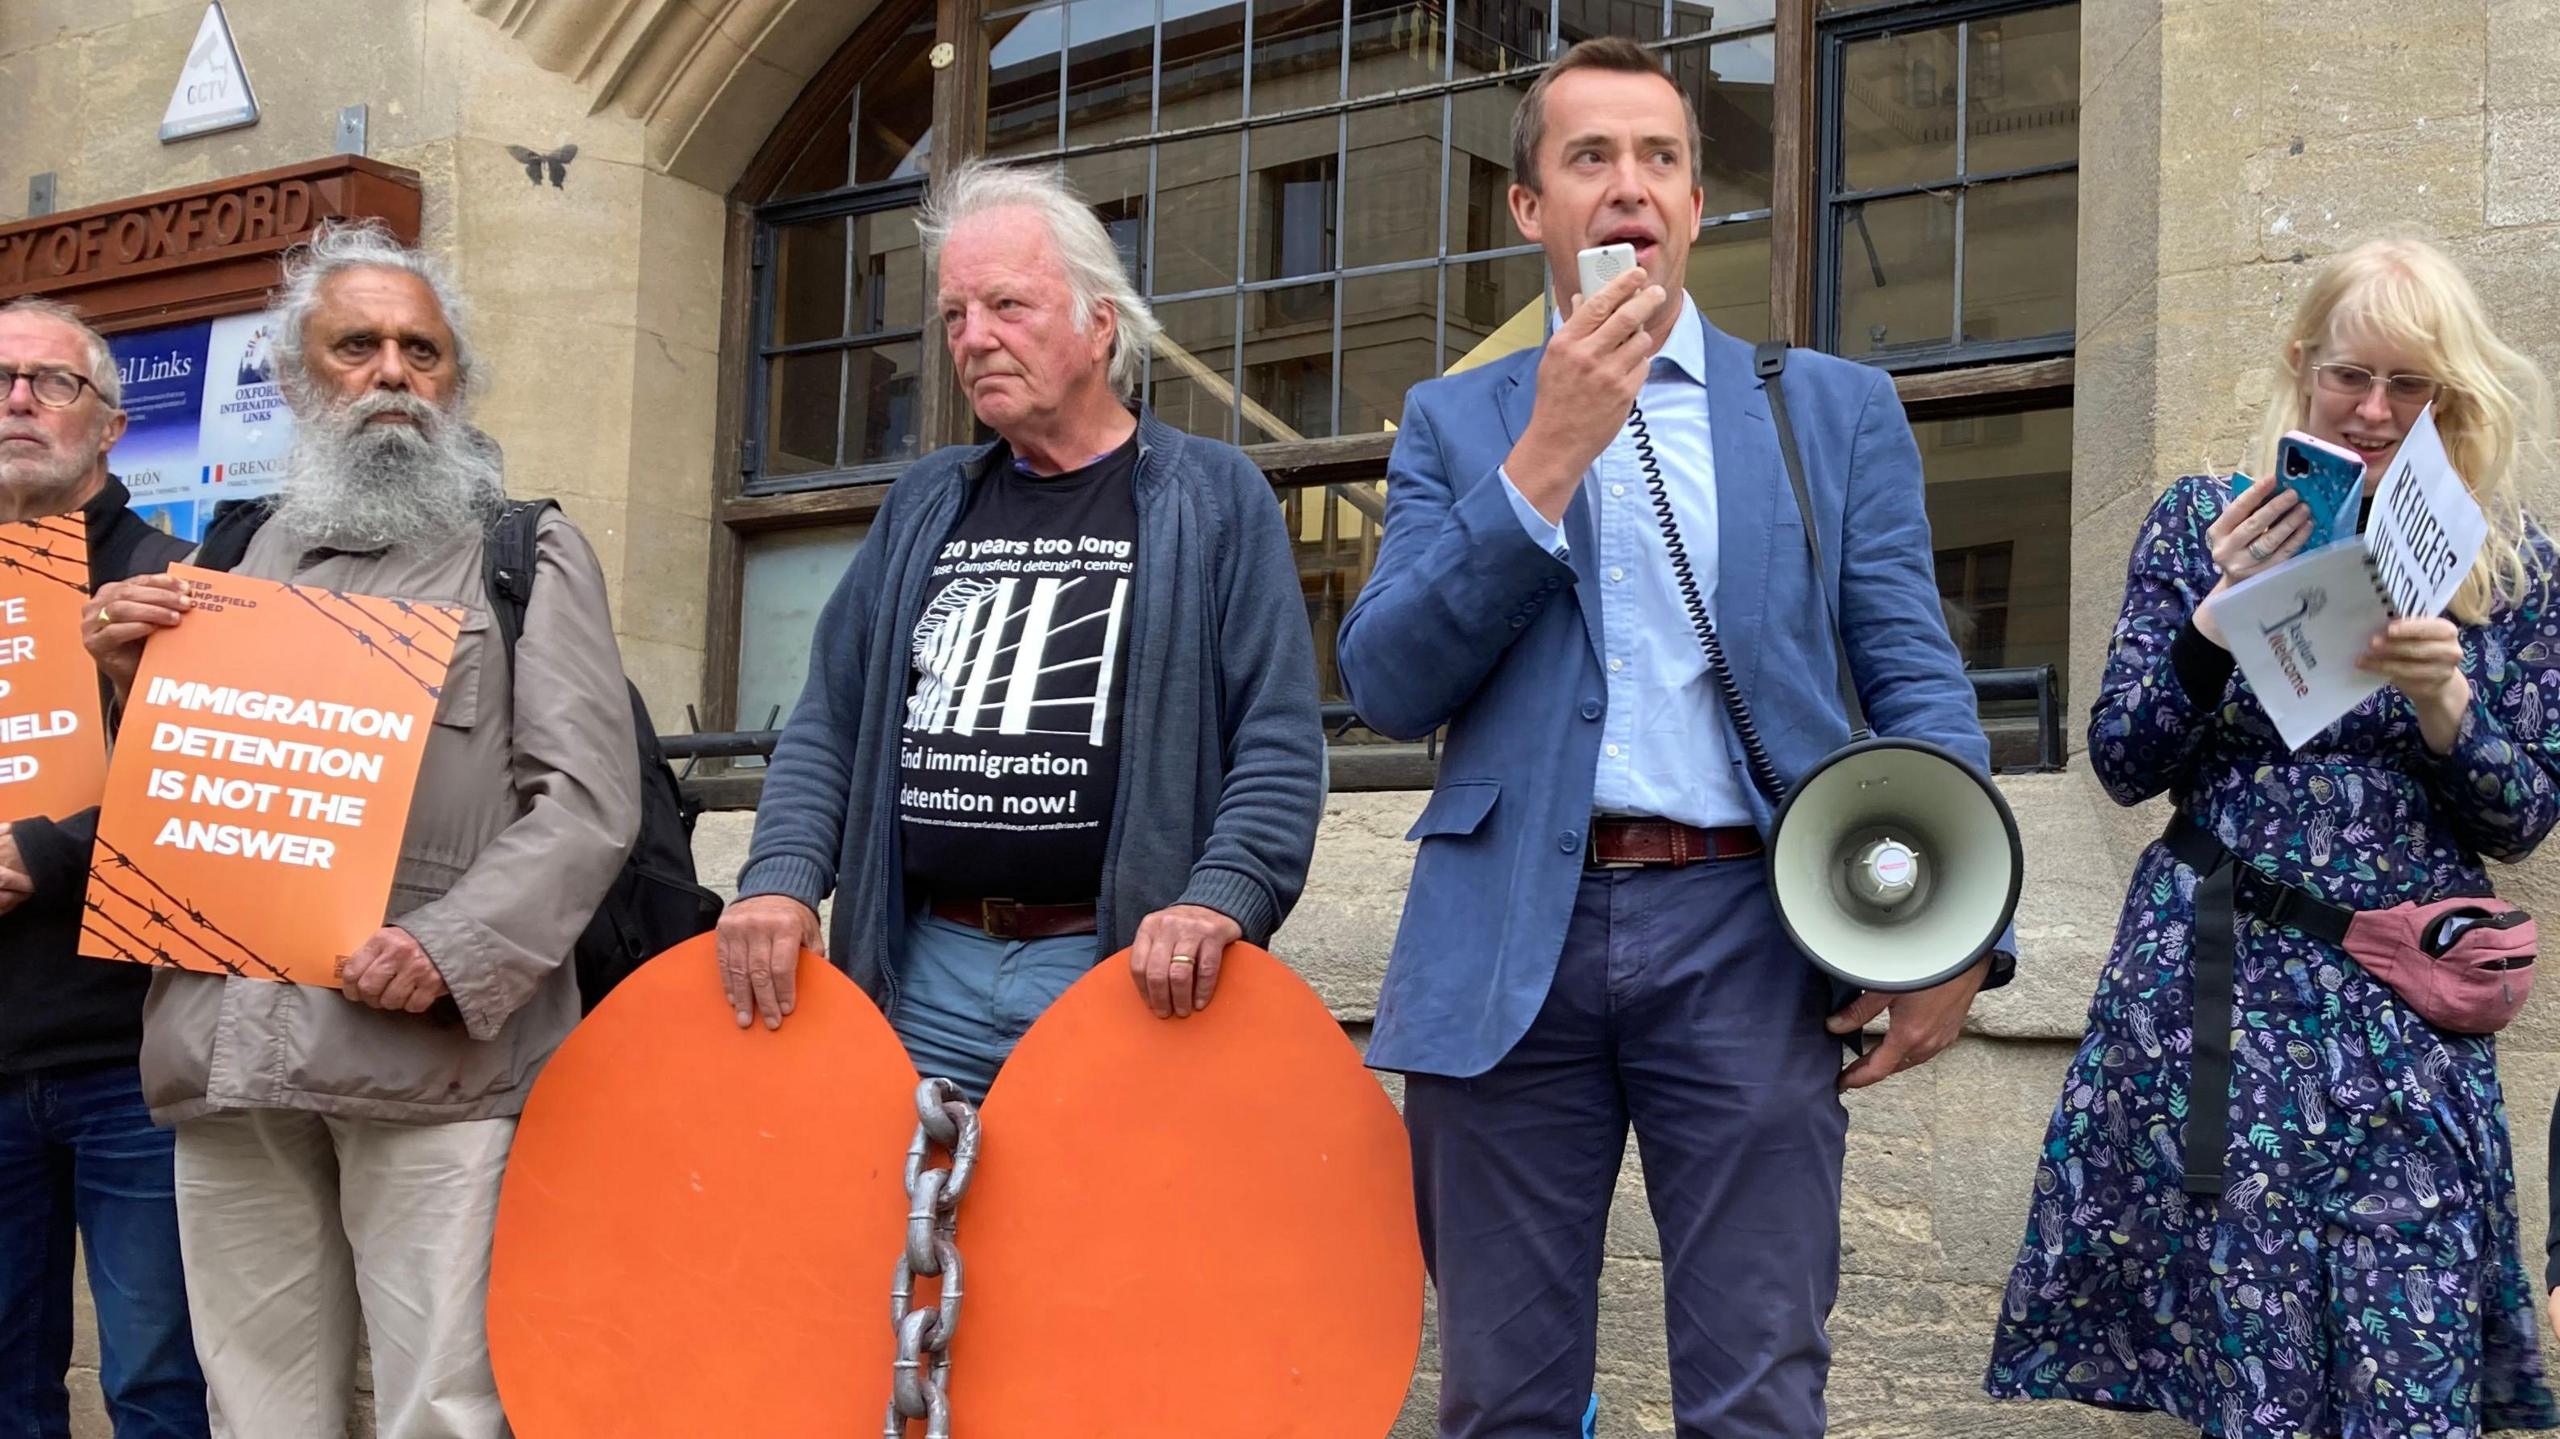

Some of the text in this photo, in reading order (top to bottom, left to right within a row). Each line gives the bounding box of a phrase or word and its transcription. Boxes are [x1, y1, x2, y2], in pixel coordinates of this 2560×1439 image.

[188, 80, 228, 104] CCTV
[50, 218, 108, 276] OF
[118, 180, 311, 265] OXFORD
[137, 350, 192, 382] Links
[220, 398, 287, 414] INTERNATION
[242, 411, 272, 423] LINKS
[2389, 459, 2458, 597] REFUGEES
[940, 535, 1131, 559] 20 years too long
[955, 559, 1020, 575] Campsfield
[1023, 559, 1081, 573] detention
[1084, 560, 1133, 573] centre!
[145, 676, 414, 742] IMMIGRATION
[151, 722, 384, 783] DETENTION
[901, 746, 1088, 779] End immigration
[147, 768, 367, 827] IS NOT THE
[900, 783, 1077, 815] detention now!
[154, 817, 336, 869] ANSWER
